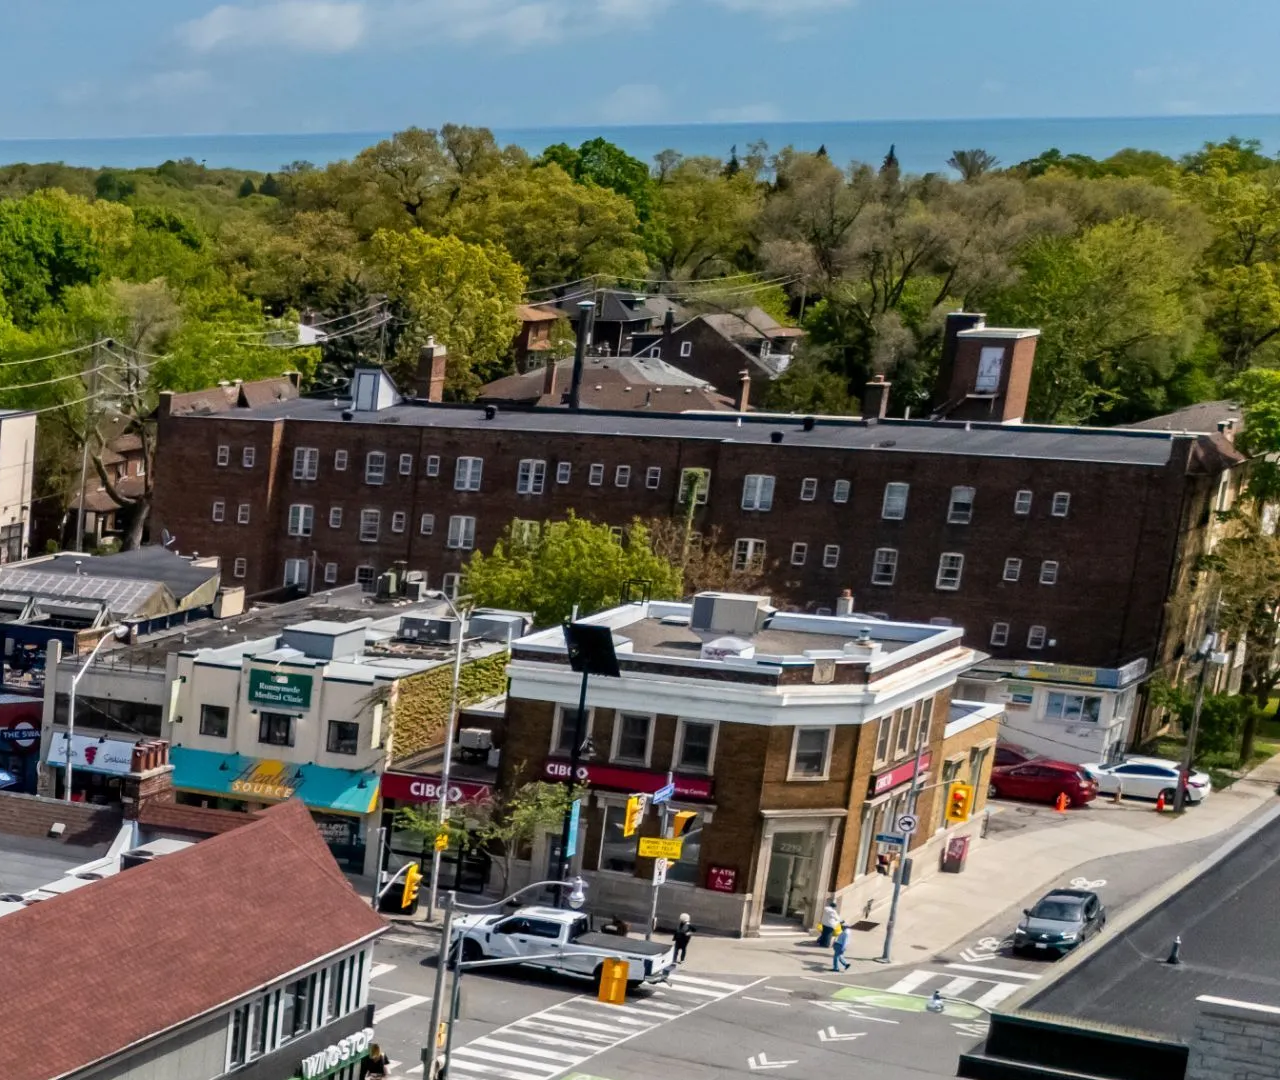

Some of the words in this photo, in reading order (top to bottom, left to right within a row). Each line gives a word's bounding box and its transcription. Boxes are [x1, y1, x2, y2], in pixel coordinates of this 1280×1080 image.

[259, 682, 301, 694] Runnymede
[254, 691, 281, 701] Medical
[282, 694, 303, 703] Clinic
[3, 730, 20, 739] THE
[21, 730, 41, 738] SWA
[231, 780, 294, 798] SOURCE
[719, 868, 736, 877] ATM
